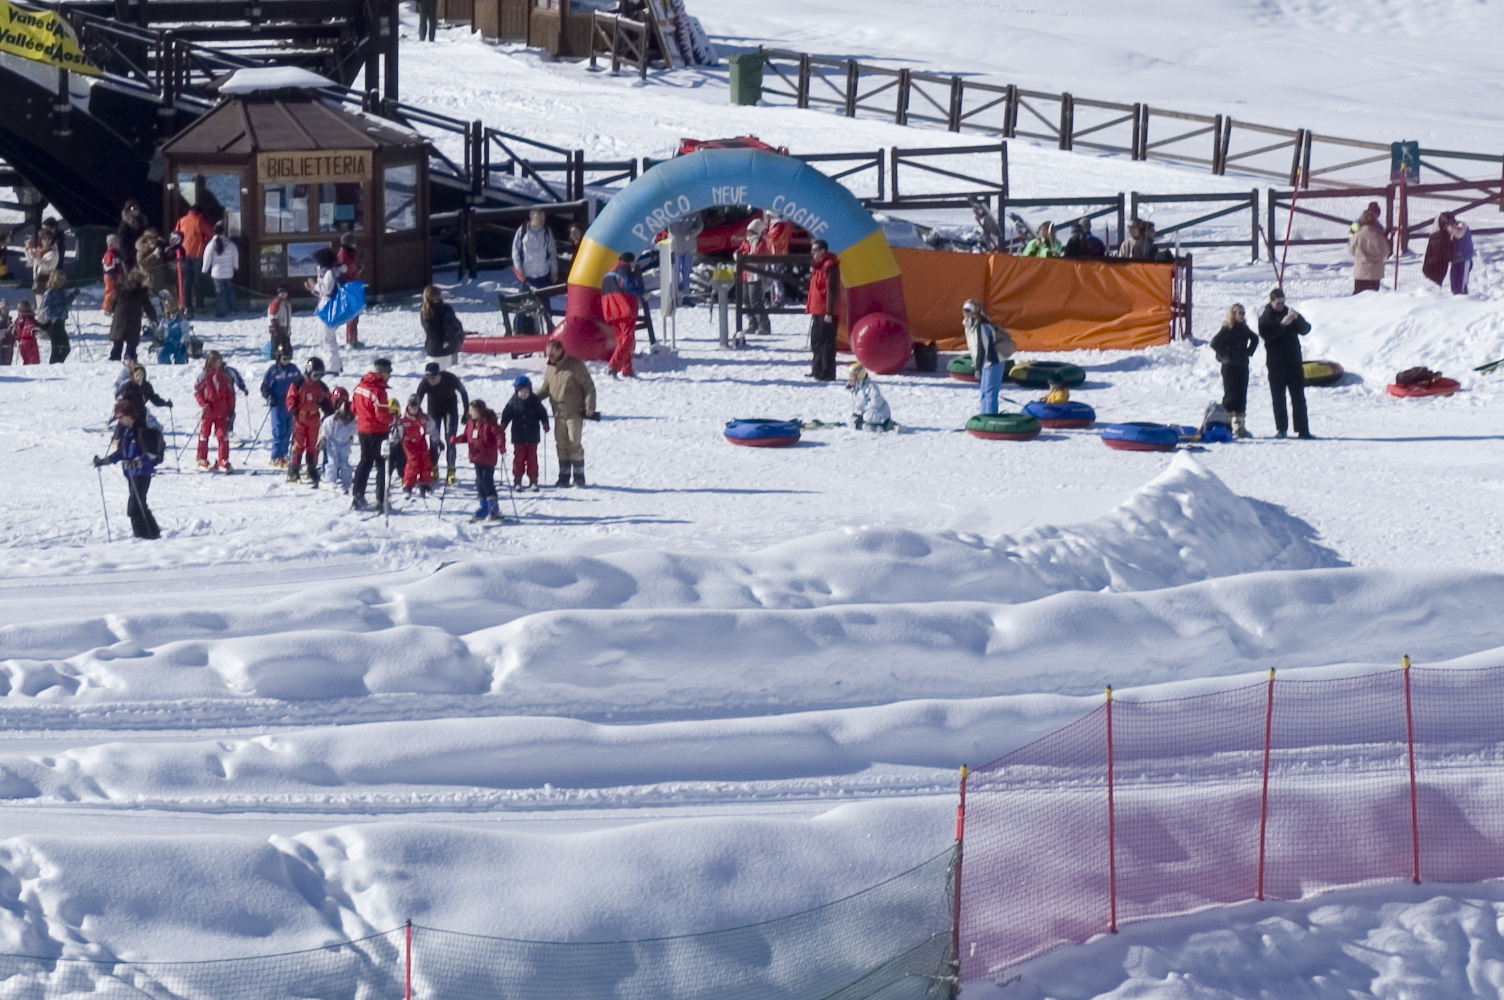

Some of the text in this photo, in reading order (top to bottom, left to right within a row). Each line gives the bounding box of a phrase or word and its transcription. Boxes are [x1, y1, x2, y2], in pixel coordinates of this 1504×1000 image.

[267, 156, 365, 177] BIGLIETTERIA
[631, 194, 691, 241] PARCO
[772, 195, 829, 237] COGNE
